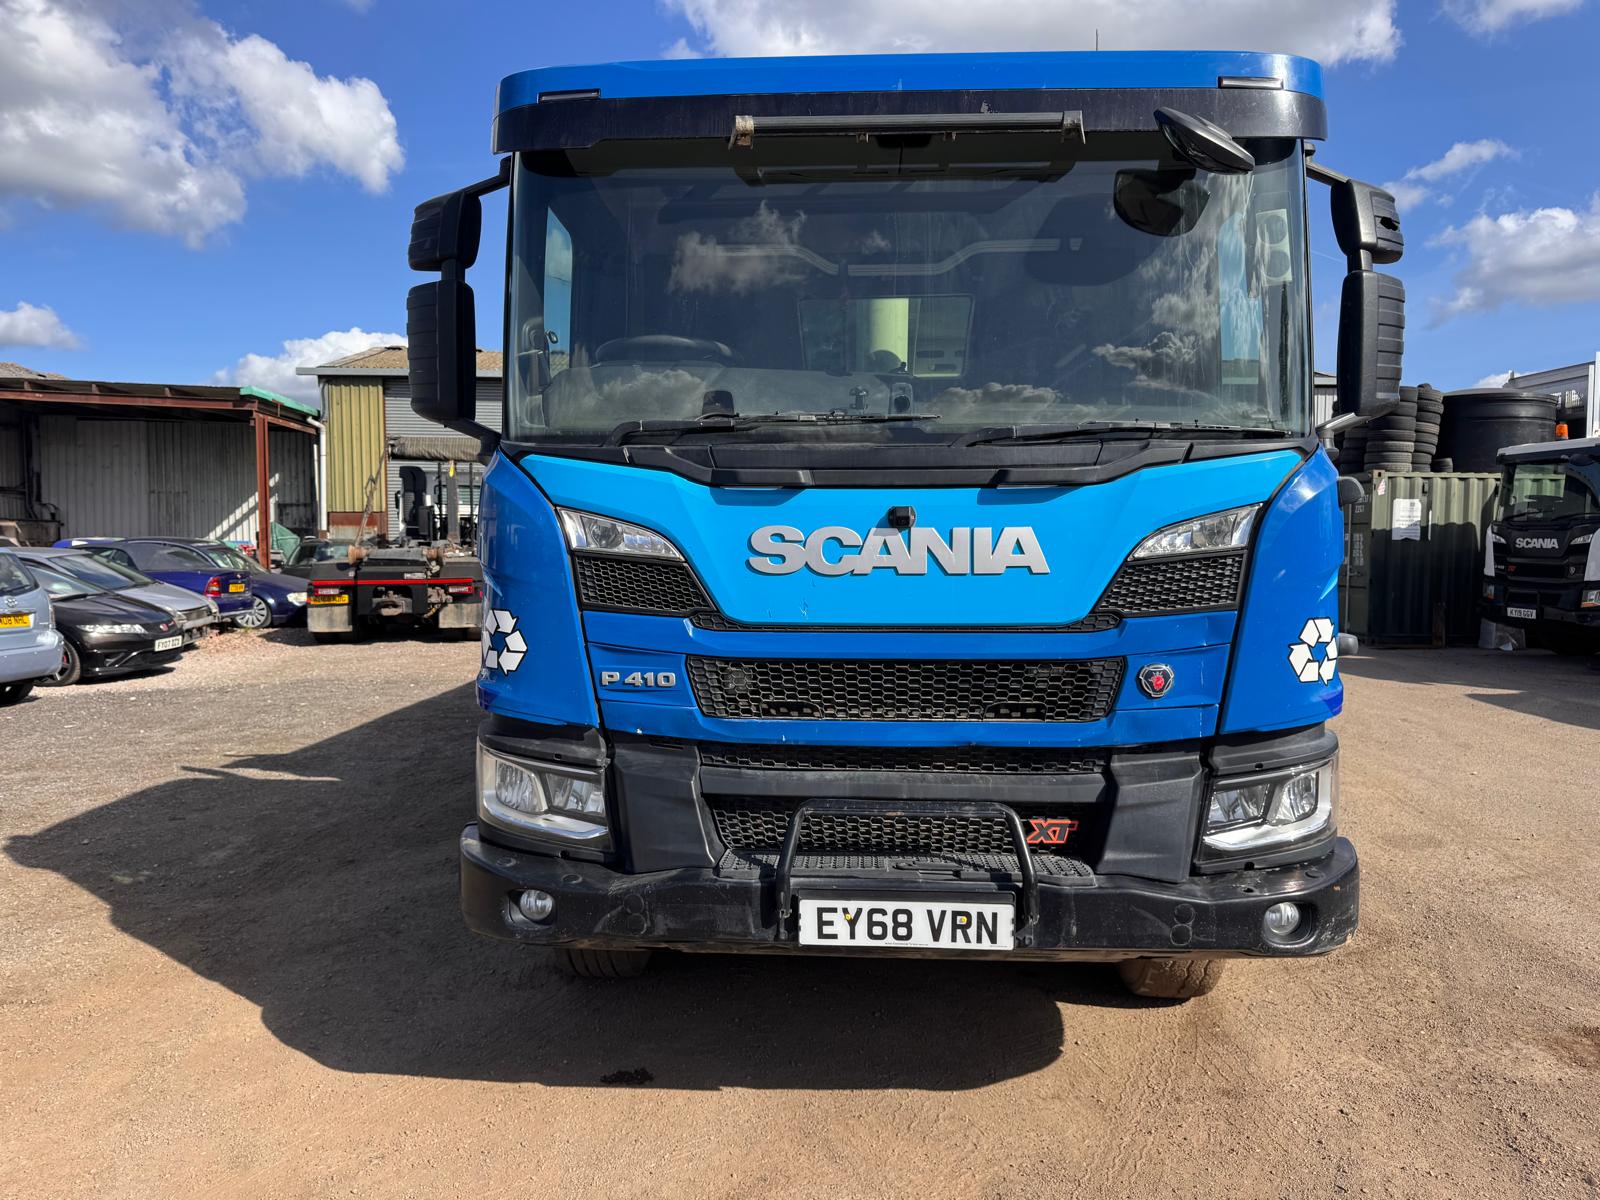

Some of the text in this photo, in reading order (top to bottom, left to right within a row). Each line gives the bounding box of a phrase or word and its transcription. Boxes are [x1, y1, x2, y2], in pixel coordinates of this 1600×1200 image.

[749, 525, 1050, 575] SCANIA
[1515, 537, 1559, 549] SCANIA
[601, 671, 676, 687] P 410
[1026, 818, 1078, 844] XT
[816, 906, 998, 945] EY68 VRN
